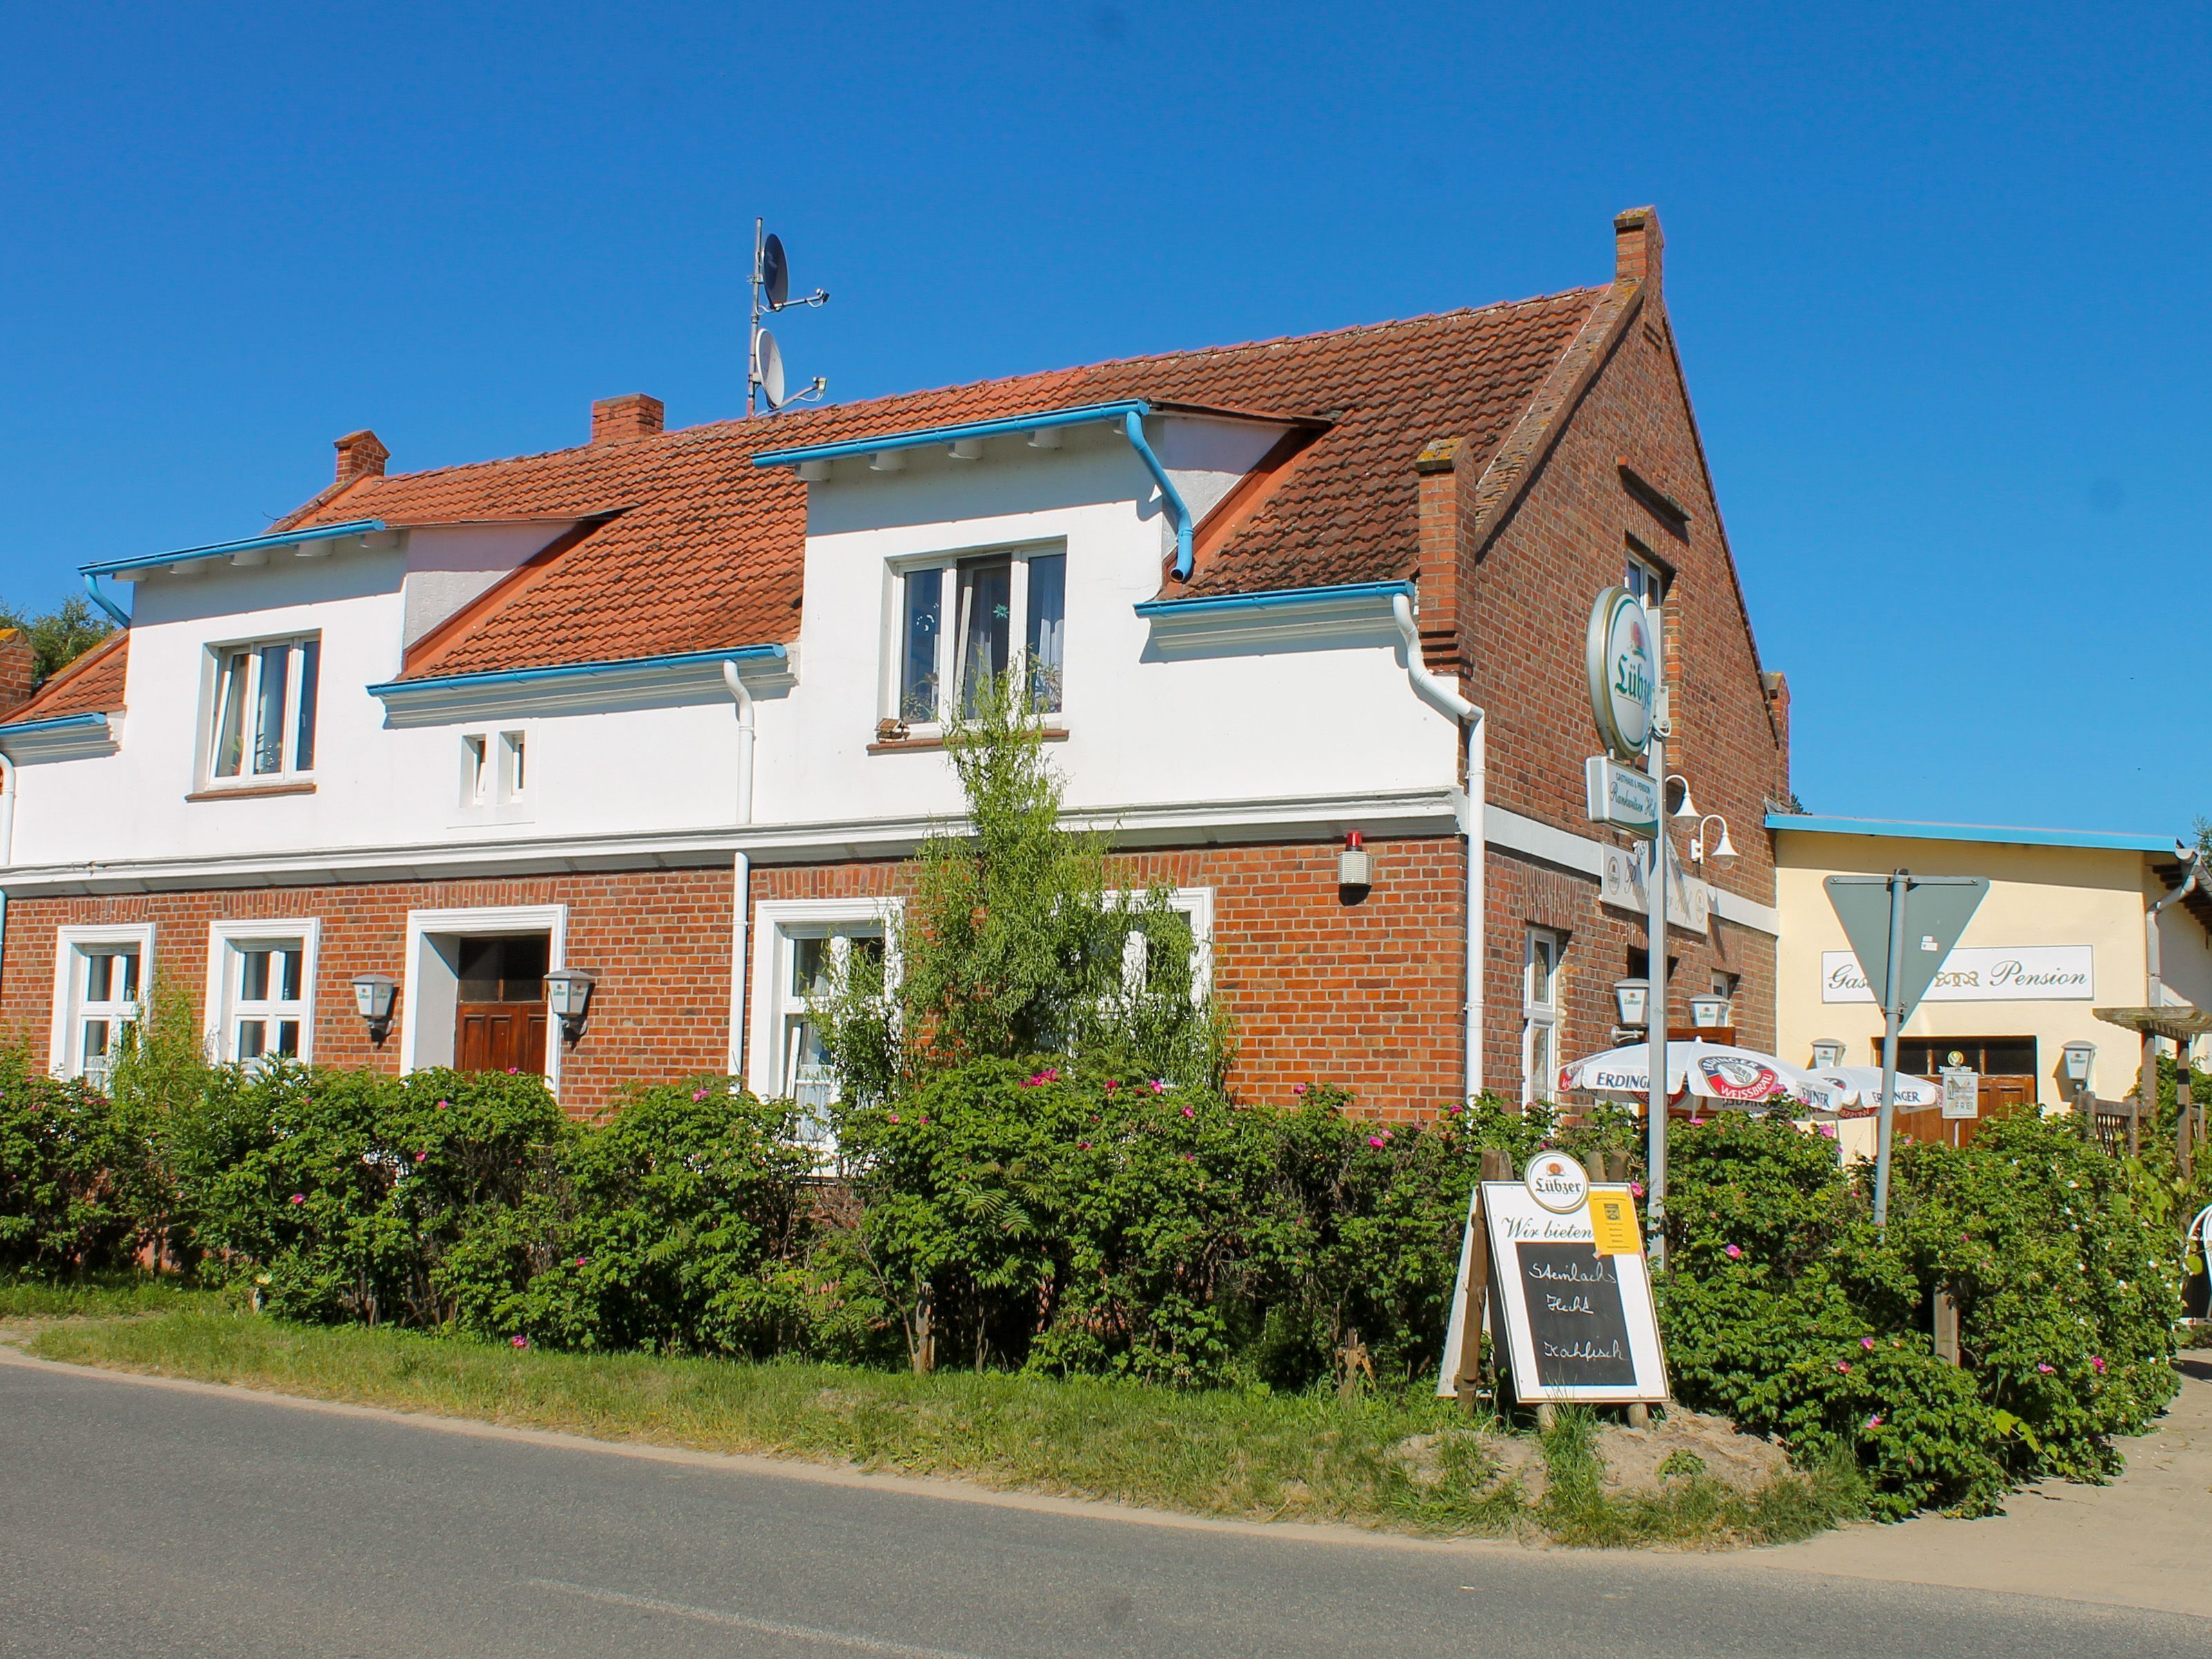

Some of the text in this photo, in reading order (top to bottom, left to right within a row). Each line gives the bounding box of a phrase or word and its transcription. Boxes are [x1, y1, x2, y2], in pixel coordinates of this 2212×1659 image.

[1989, 960, 2088, 986] Pension
[1703, 1057, 1759, 1071] ERDINGER
[1596, 1071, 1650, 1088] ERDING
[1871, 1091, 1921, 1103] ERNGER
[1535, 1178, 1581, 1194] Lübzer
[1501, 1217, 1594, 1238] Wir bieten
[1546, 1293, 1594, 1315] Hecht
